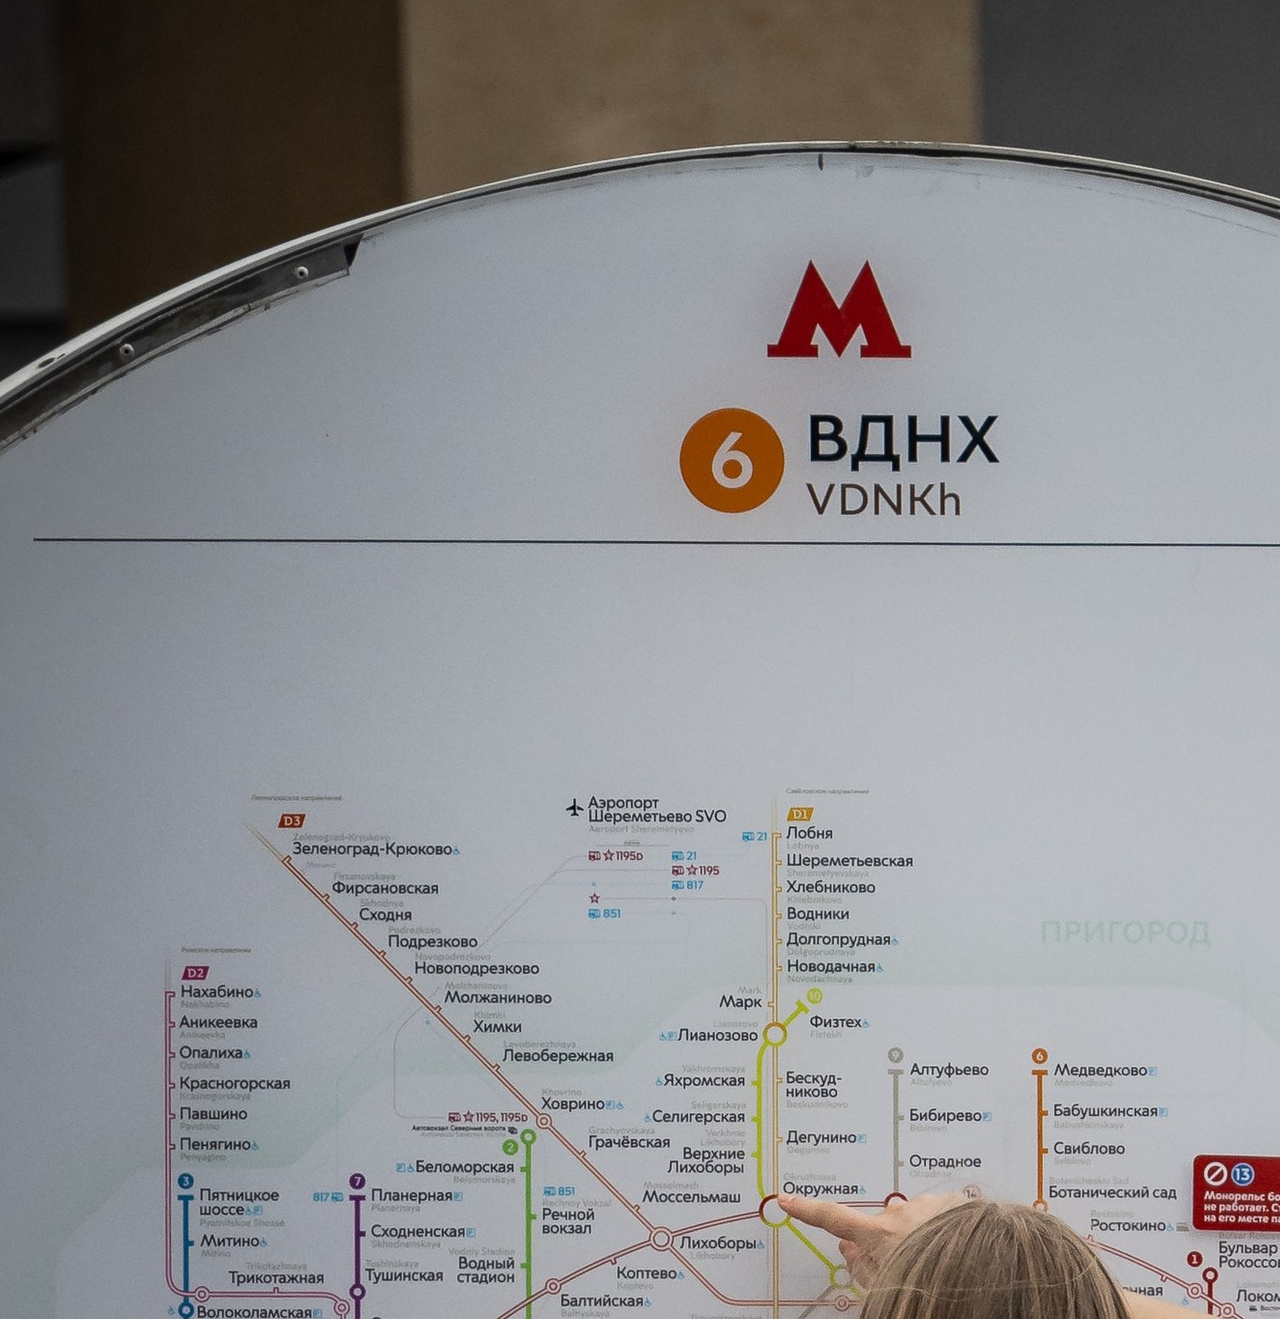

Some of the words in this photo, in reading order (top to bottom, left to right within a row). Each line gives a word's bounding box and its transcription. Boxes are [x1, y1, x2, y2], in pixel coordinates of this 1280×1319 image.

[809, 414, 1000, 472] ВДНХ
[711, 431, 755, 489] 6
[805, 482, 961, 516] VDNKh
[588, 796, 660, 811] Аэропорт
[588, 809, 693, 825] Шереметьево
[695, 810, 727, 823] SVO
[786, 826, 833, 840] Лобня
[292, 841, 453, 858] Зеленоград-Крюково
[786, 854, 914, 869] Шереметьевская
[699, 865, 720, 876] 1195
[331, 881, 439, 896] Фирсановская
[786, 880, 876, 895] Хлебниково
[359, 908, 412, 923] Сходня
[786, 907, 850, 921] Водники
[786, 933, 891, 948] Долгопрудная
[1040, 920, 1211, 948] ПРИГОРОД
[388, 935, 478, 951] Подрезково
[414, 961, 540, 977] Новоподрезково
[786, 960, 876, 974] Новодачная
[180, 984, 254, 999] Нахабино
[444, 990, 552, 1005] Молжаниново
[719, 995, 762, 1011] Марк
[179, 1016, 259, 1029] Аникеевка
[473, 1019, 522, 1033] Химки
[810, 1014, 862, 1030] Физтех
[678, 1029, 759, 1043] Лианозово
[179, 1046, 243, 1060] Опалиха
[502, 1048, 614, 1065] Левобережная
[910, 1063, 989, 1079] Алтуфьево
[1054, 1064, 1148, 1078] Медведково
[179, 1077, 290, 1092] Красногорская
[663, 1075, 746, 1090] Яхромская
[785, 1071, 843, 1088] Бескуд-
[786, 1087, 838, 1098] никово
[540, 1098, 605, 1113] Ховрино
[1053, 1104, 1158, 1119] Бабушкинская
[179, 1107, 248, 1121] Павшино
[475, 1112, 499, 1124] 1195,
[652, 1110, 746, 1126] Селигерская
[909, 1109, 983, 1125] Бибирево
[588, 1135, 671, 1150] Грачёвская
[786, 1131, 857, 1146] Дегунино
[682, 1148, 745, 1163] Верхние
[1053, 1142, 1126, 1156] Свиблово
[415, 1160, 515, 1175] Беломорская
[667, 1161, 745, 1176] Лихоборы
[909, 1155, 982, 1170] Отрадное
[1235, 1167, 1251, 1182] 13
[200, 1188, 280, 1204] Пятницкое
[371, 1189, 453, 1204] Планерная
[642, 1190, 741, 1204] Моссельмаш
[782, 1182, 859, 1198] Окружная
[1048, 1185, 1150, 1200] Ботанический
[1152, 1187, 1177, 1201] сад
[1203, 1190, 1265, 1205] Монорельс
[200, 1205, 245, 1216] шоссе
[541, 1208, 595, 1223] Речной
[1203, 1204, 1217, 1213] не
[1218, 1201, 1269, 1215] работает.
[1090, 1219, 1167, 1233] Ростокино
[1203, 1214, 1217, 1224] на
[1218, 1214, 1235, 1226] его
[1237, 1214, 1268, 1224] месте
[370, 1225, 466, 1239] Сходненская
[541, 1223, 592, 1235] вокзал
[200, 1235, 260, 1248] Митино
[680, 1237, 757, 1251] Лихоборы
[1218, 1240, 1278, 1256] Бульвар
[458, 1256, 515, 1271] Водный
[227, 1271, 325, 1286] Трикотажная
[456, 1272, 515, 1285] стадион
[560, 1294, 644, 1308] Балтийская
[196, 1305, 312, 1319] Волоколамская
